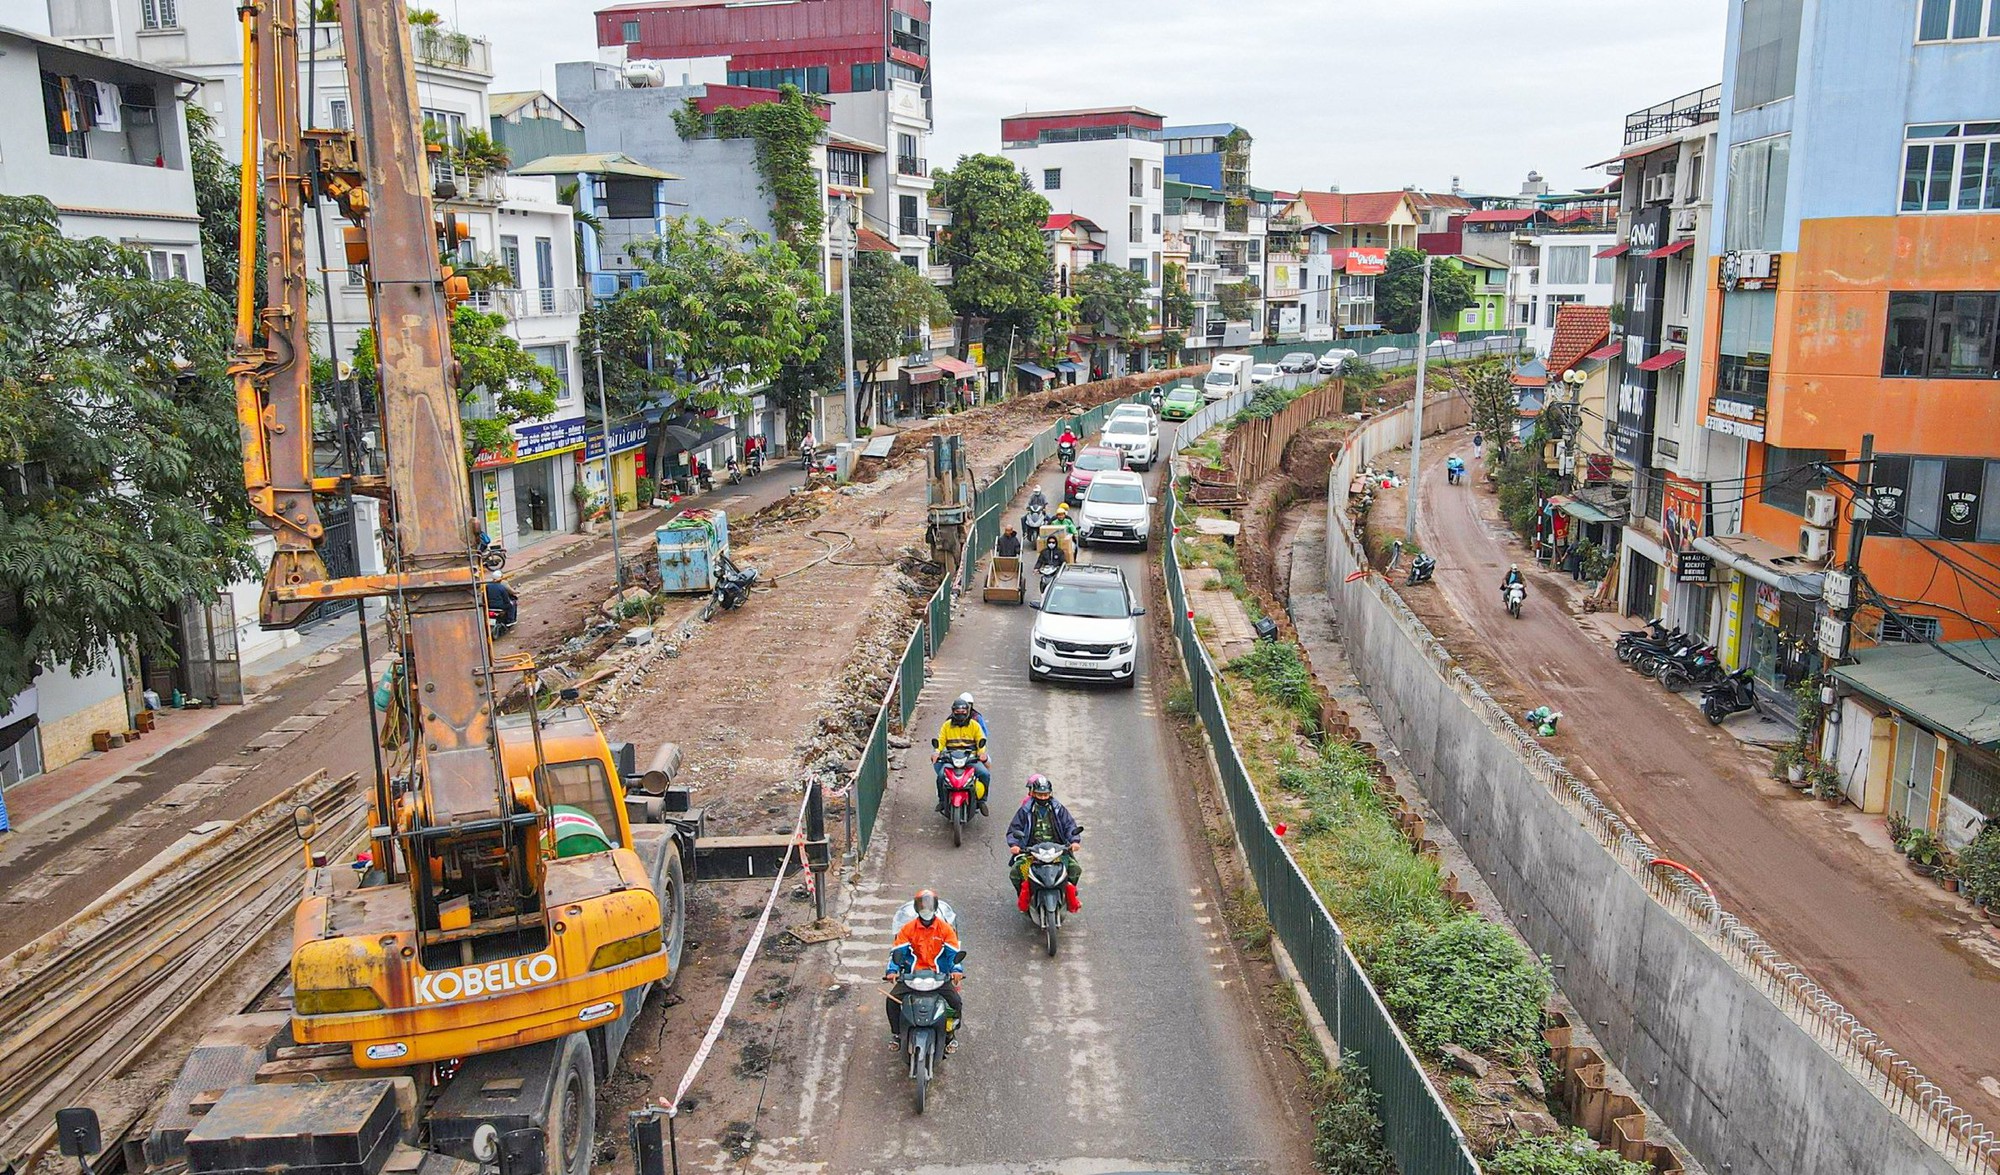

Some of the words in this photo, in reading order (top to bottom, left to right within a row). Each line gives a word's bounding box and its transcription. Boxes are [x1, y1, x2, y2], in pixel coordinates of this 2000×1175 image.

[1874, 486, 1888, 496] THE
[1947, 492, 1960, 501] THE
[1961, 492, 1977, 502] LION
[413, 954, 558, 1004] KOBELCO
